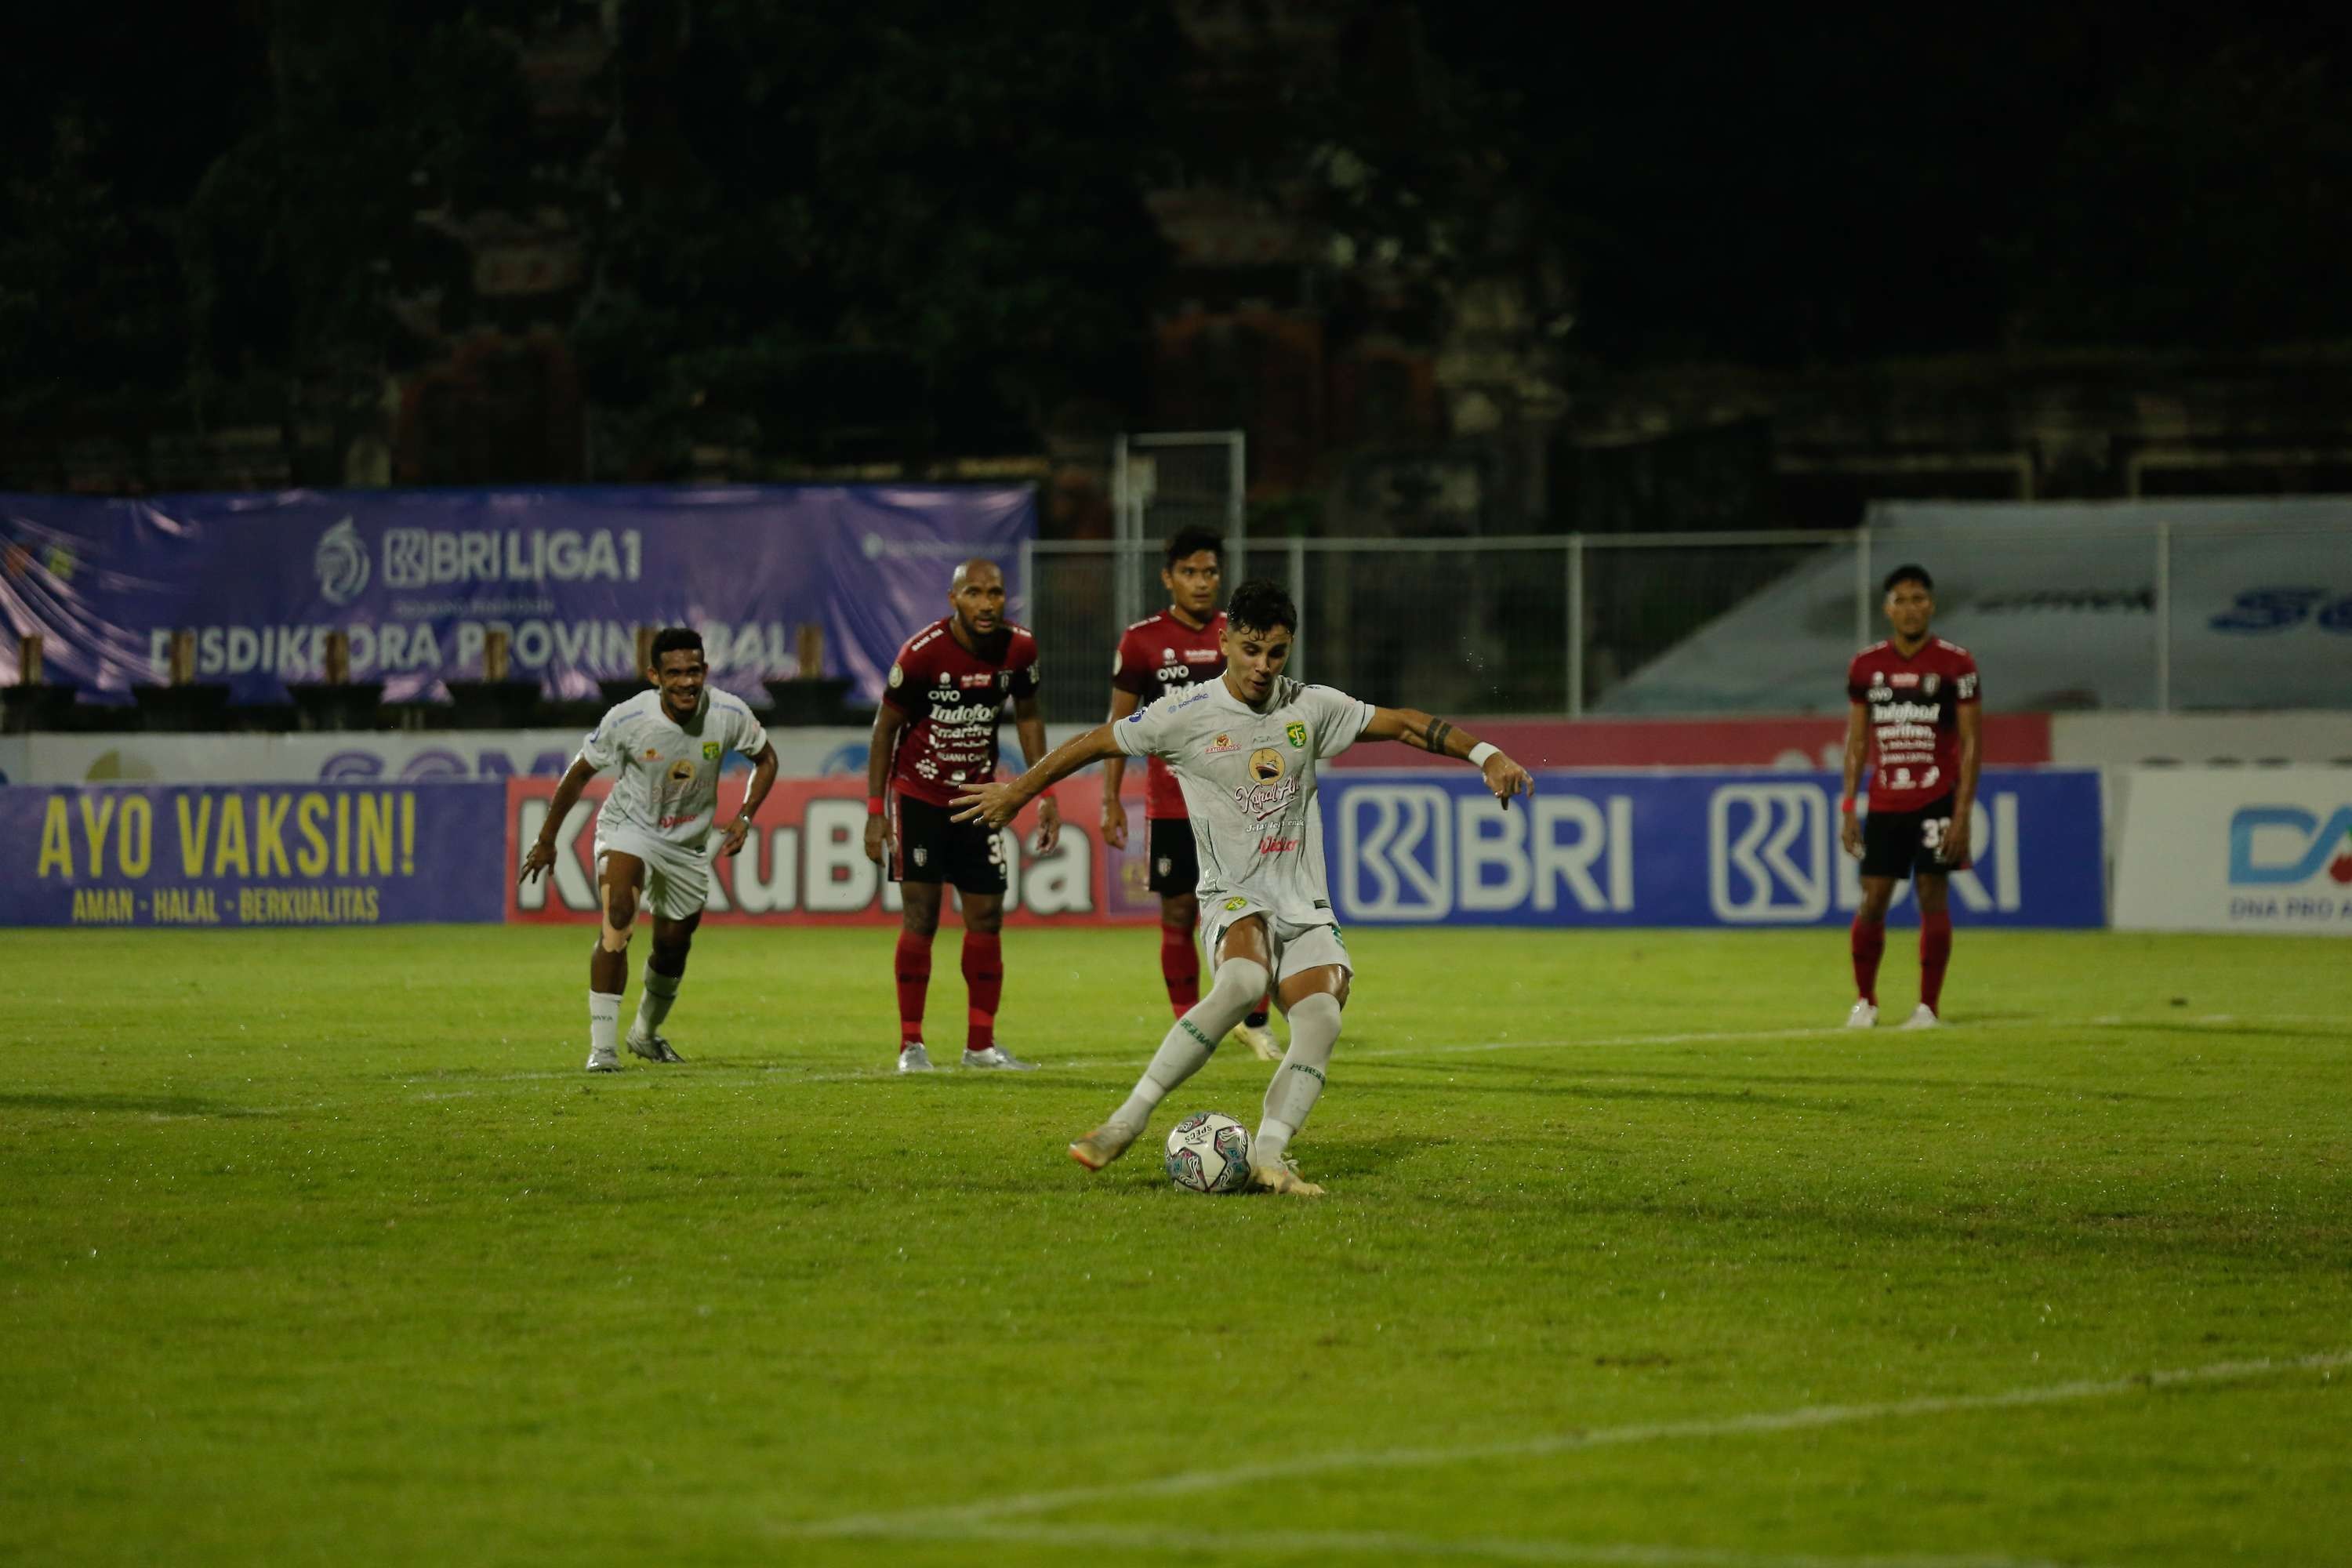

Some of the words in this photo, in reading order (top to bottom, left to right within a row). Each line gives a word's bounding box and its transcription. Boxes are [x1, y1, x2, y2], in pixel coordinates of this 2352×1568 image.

[1157, 665, 1189, 681] OVO
[928, 690, 960, 702] OVO
[38, 793, 154, 878] AYO
[176, 790, 416, 878] VAKSIN!
[1456, 794, 1635, 912] BRI
[72, 887, 134, 923] AMAN
[153, 887, 220, 923] HALAL
[239, 887, 379, 923] BERKUALITAS
